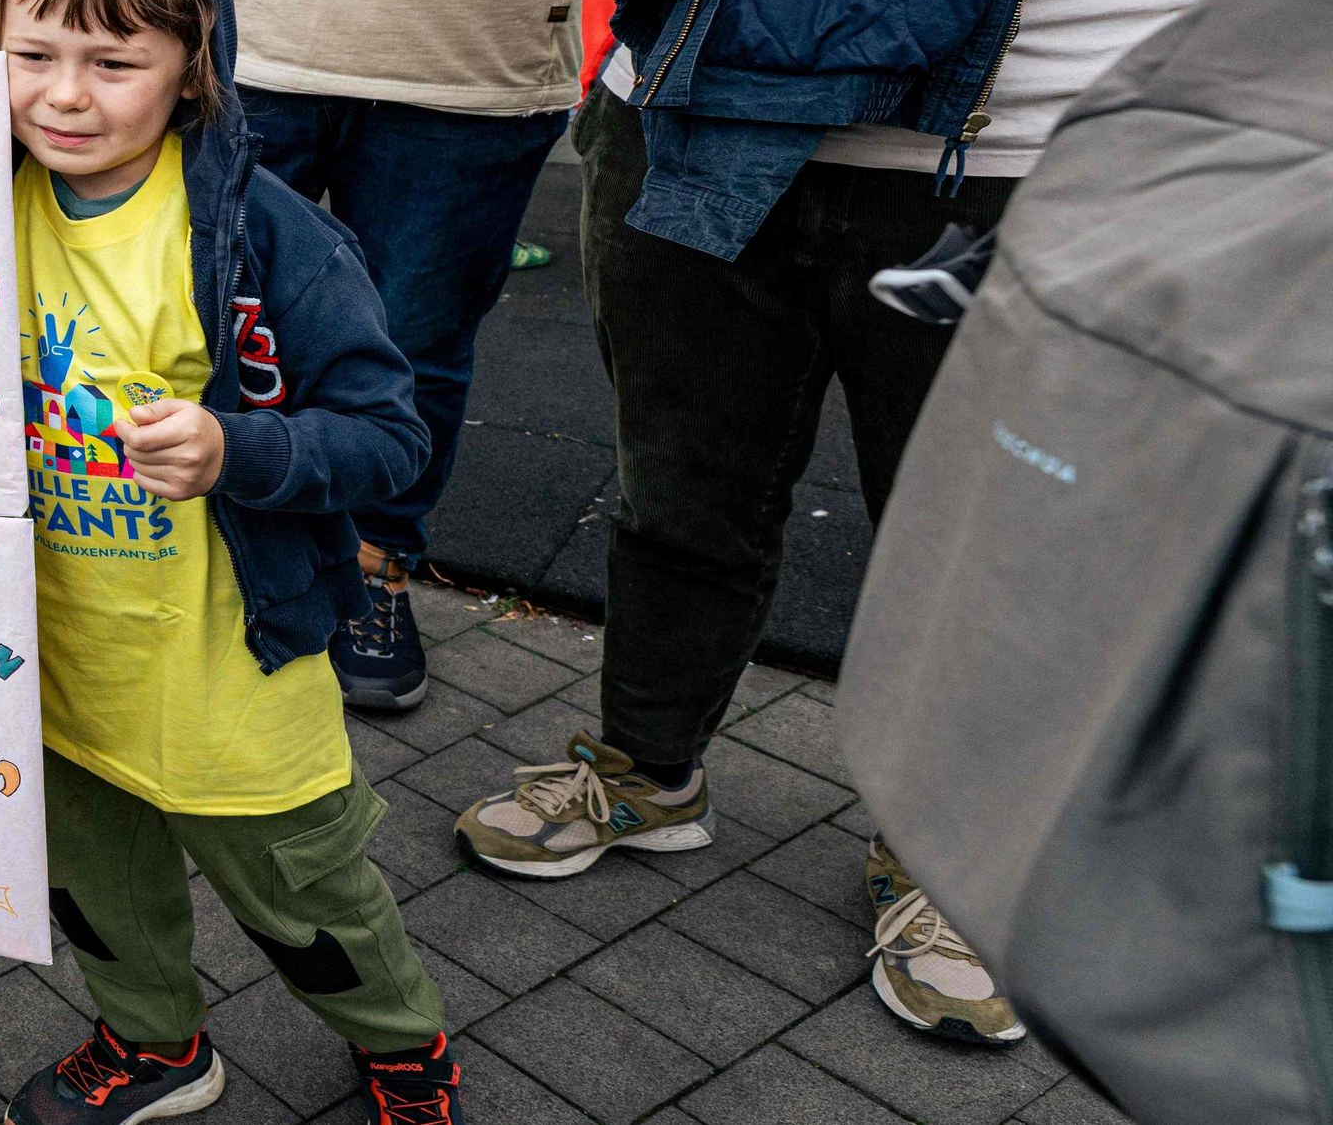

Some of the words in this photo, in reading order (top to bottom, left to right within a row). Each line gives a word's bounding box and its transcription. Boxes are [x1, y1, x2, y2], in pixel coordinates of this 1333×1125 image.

[28, 469, 92, 502] ILLE
[29, 494, 174, 541] FANTS
[369, 1062, 424, 1073] KangaROOS
